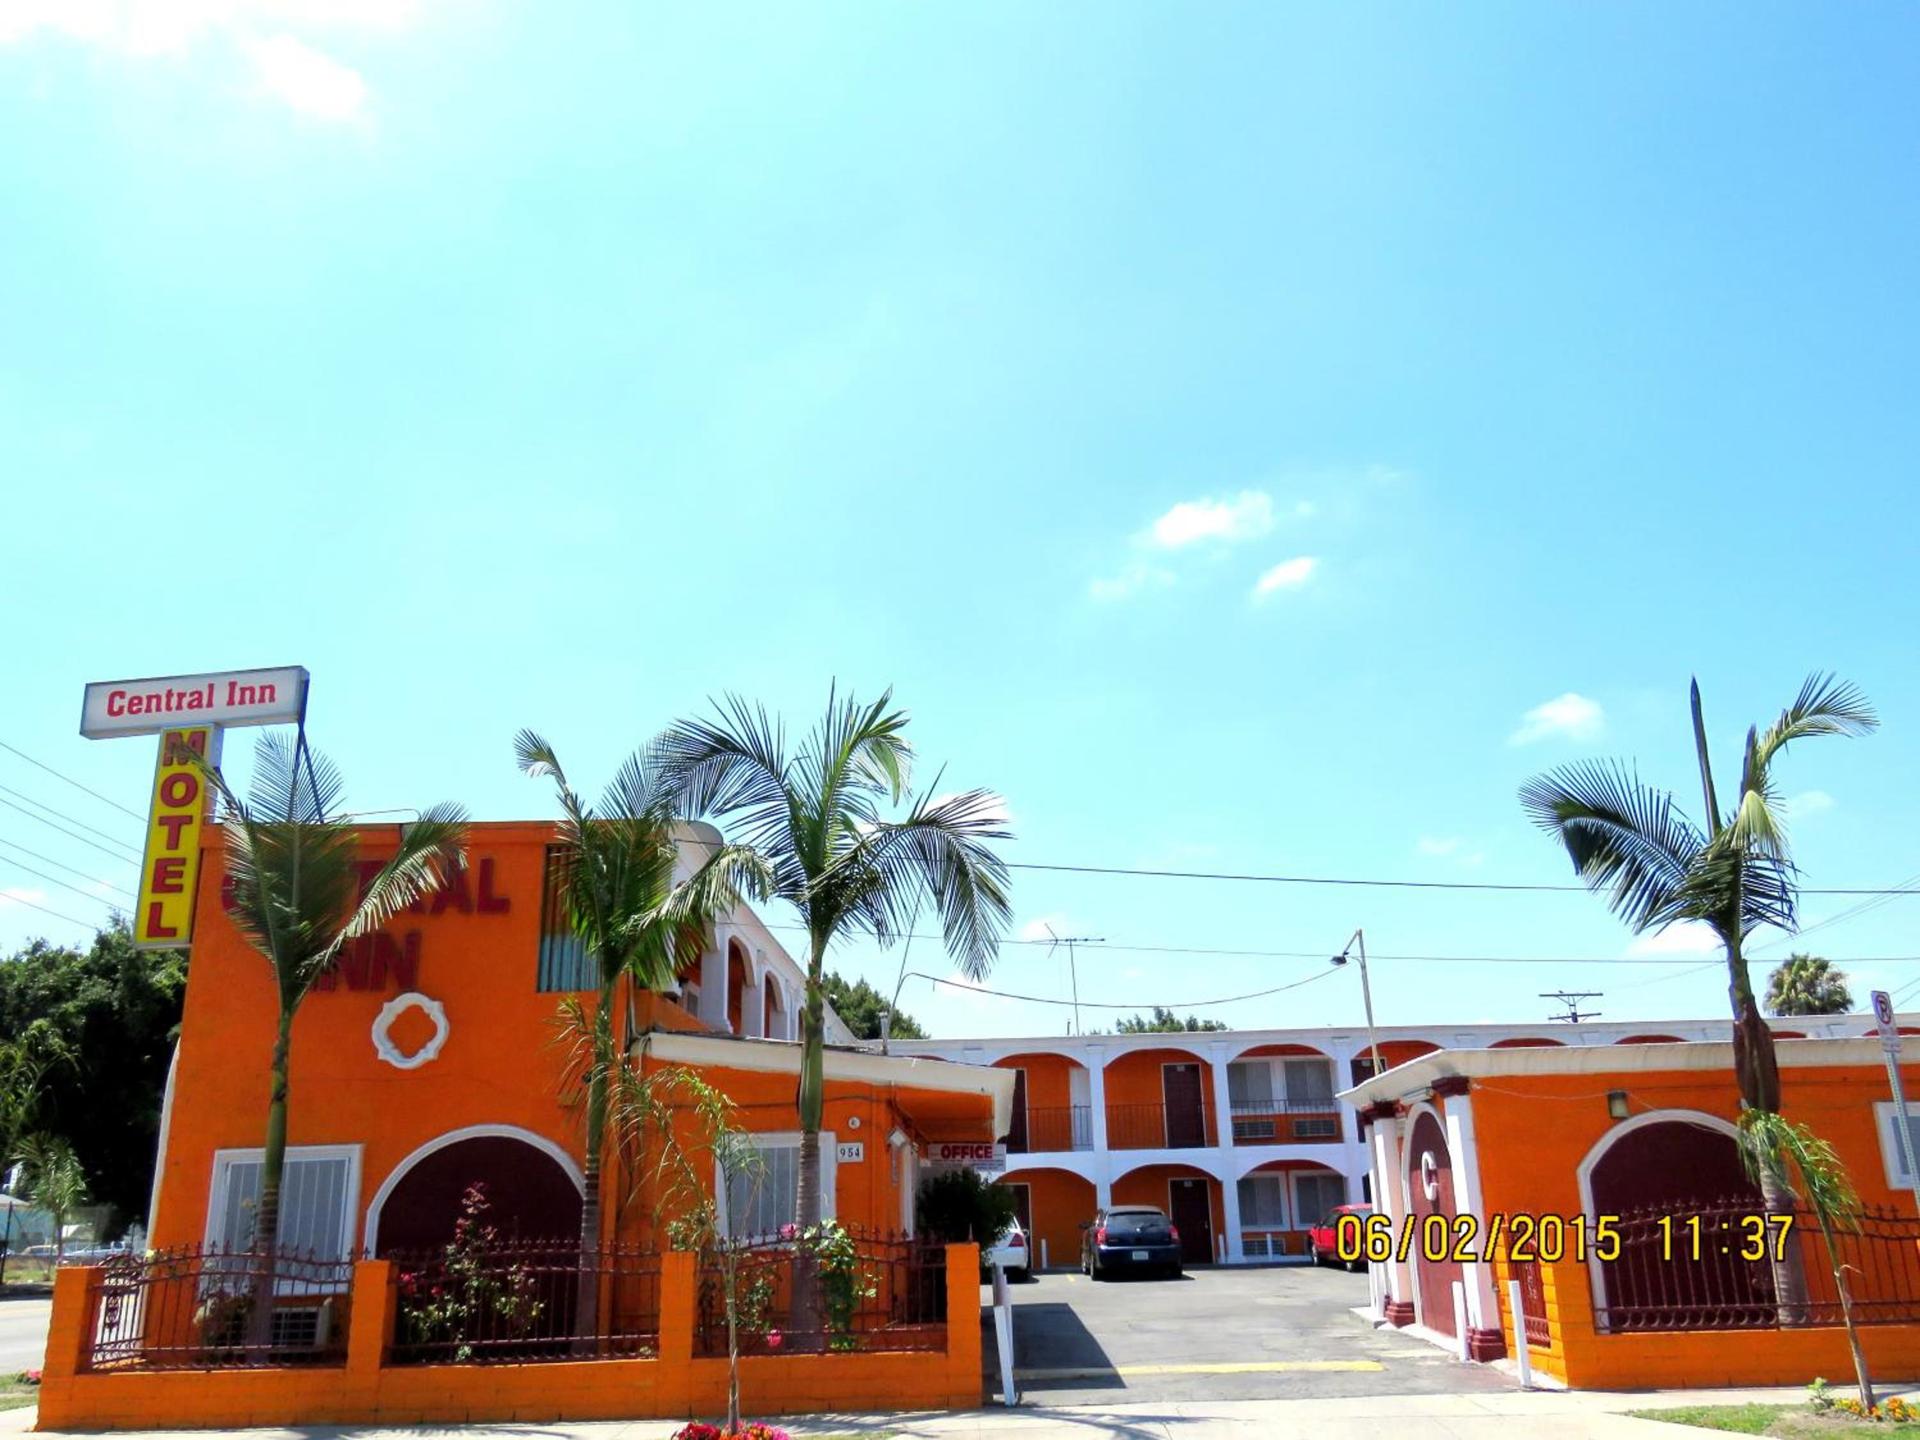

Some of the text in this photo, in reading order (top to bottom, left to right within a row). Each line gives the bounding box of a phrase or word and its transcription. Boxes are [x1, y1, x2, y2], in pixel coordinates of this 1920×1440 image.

[106, 681, 276, 717] Central Inn
[146, 730, 207, 939] MOTEL
[840, 1147, 860, 1158] 954
[940, 1145, 993, 1159] OFFICE
